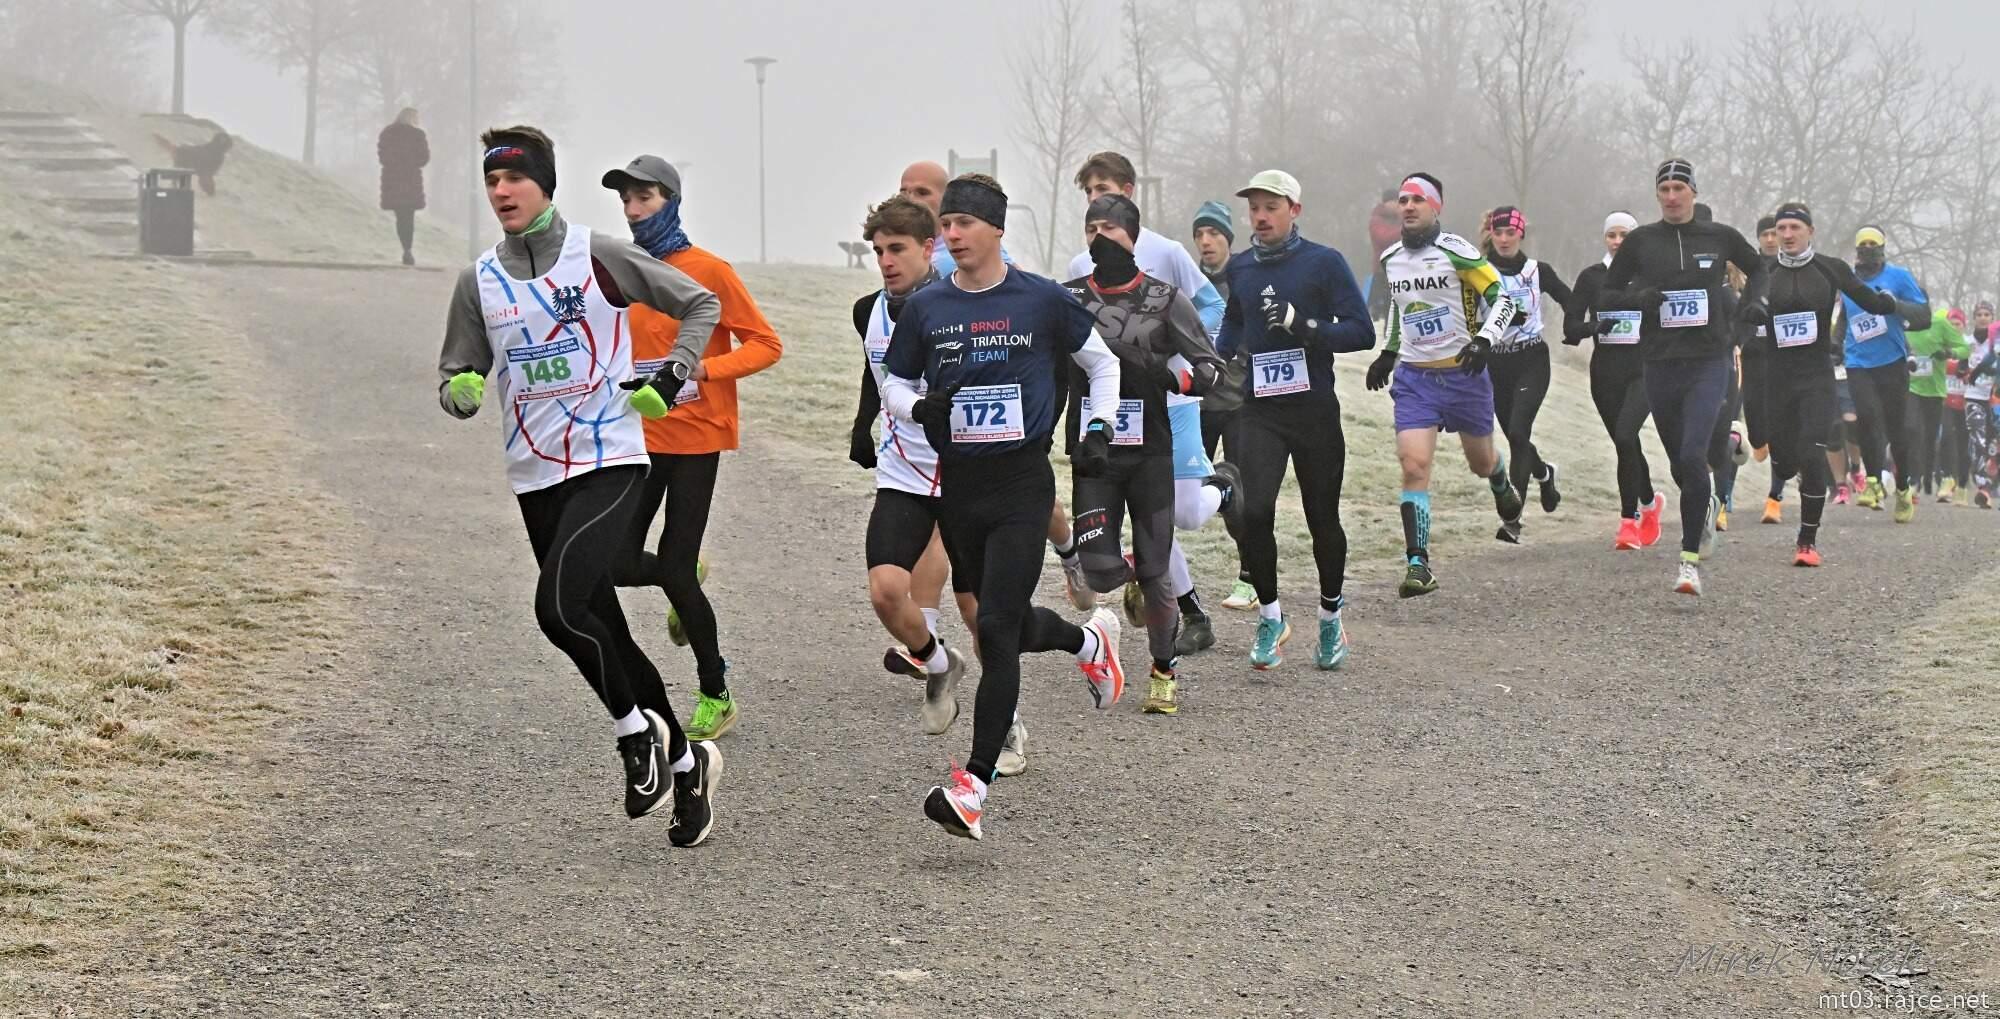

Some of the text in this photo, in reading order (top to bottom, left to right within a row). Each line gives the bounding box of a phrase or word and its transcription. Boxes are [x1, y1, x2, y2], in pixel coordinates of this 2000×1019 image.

[1669, 300, 1699, 316] 178
[1415, 317, 1444, 336] 191
[1782, 322, 1808, 337] 175
[1857, 317, 1878, 334] 193
[521, 355, 572, 386] 148
[1262, 362, 1295, 384] 179
[962, 401, 1007, 427] 172
